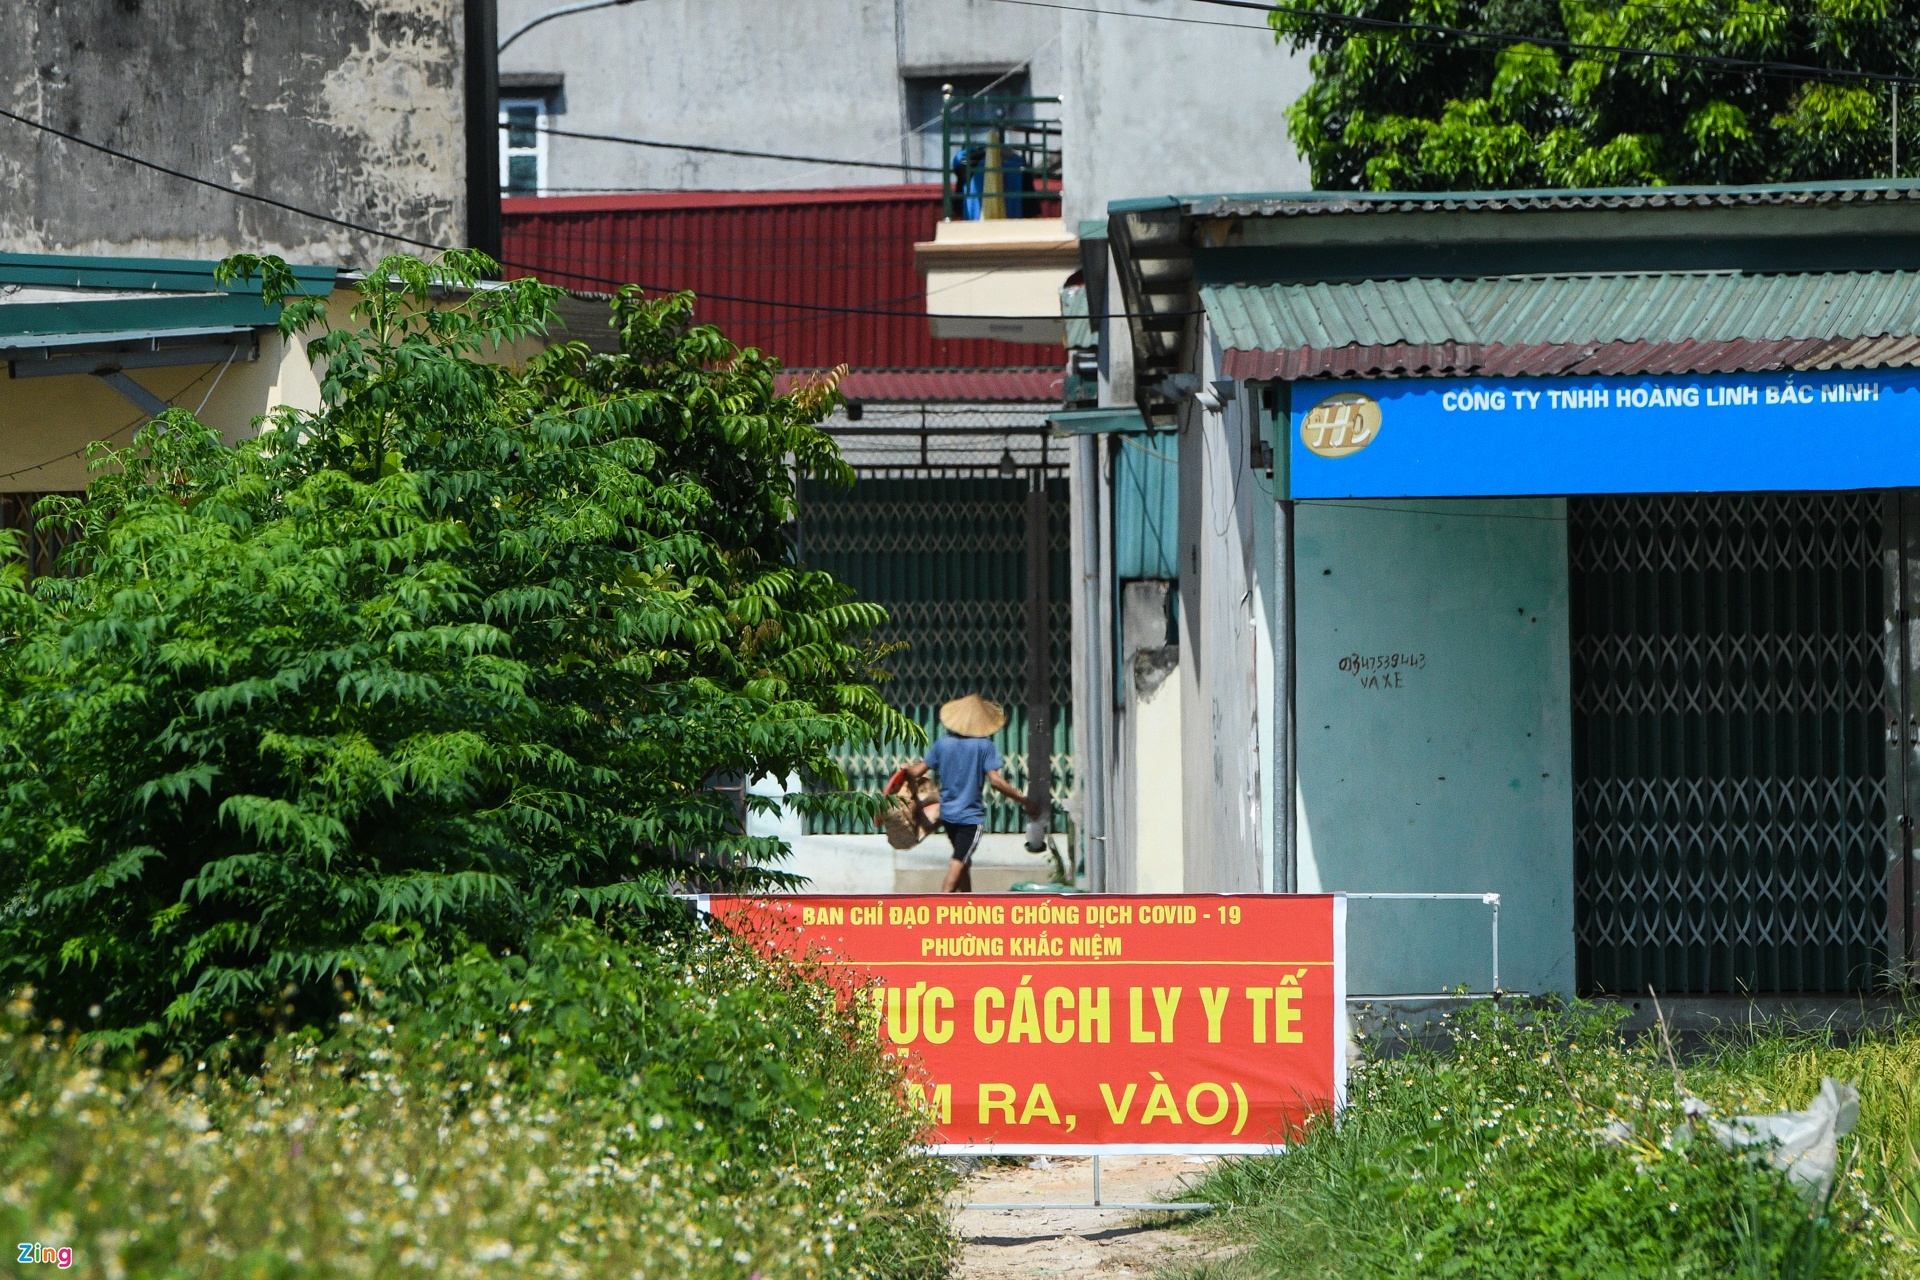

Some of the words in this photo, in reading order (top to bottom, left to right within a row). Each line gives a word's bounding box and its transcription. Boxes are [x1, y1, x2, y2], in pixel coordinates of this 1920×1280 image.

[1442, 388, 1506, 412] CÔNG
[1512, 391, 1541, 410] TY
[1547, 389, 1609, 410] TNHH
[1616, 383, 1700, 408] HOÀNG
[1706, 385, 1758, 406] LINH
[1765, 373, 1814, 405] BẮC
[1821, 382, 1879, 403] NINH
[802, 907, 844, 925] BAN
[850, 900, 884, 926] CHỈ
[889, 905, 930, 929] ĐẠO
[936, 901, 1005, 925] PHÒNG
[1011, 900, 1080, 925] CHỐNG
[1086, 905, 1133, 929] DỊCH
[1138, 905, 1197, 924] COVID
[1217, 905, 1242, 925] 19
[921, 933, 1004, 957] PHƯỜNG
[1010, 930, 1064, 957] KHẮC
[1069, 933, 1122, 960] NIỆM
[973, 974, 1110, 1044] CÁCH
[1129, 986, 1182, 1043] LY
[1199, 986, 1230, 1043] Y
[1246, 968, 1307, 1043] TẾ
[978, 1083, 1076, 1133] RA,
[1099, 1071, 1249, 1136] VÀO)
